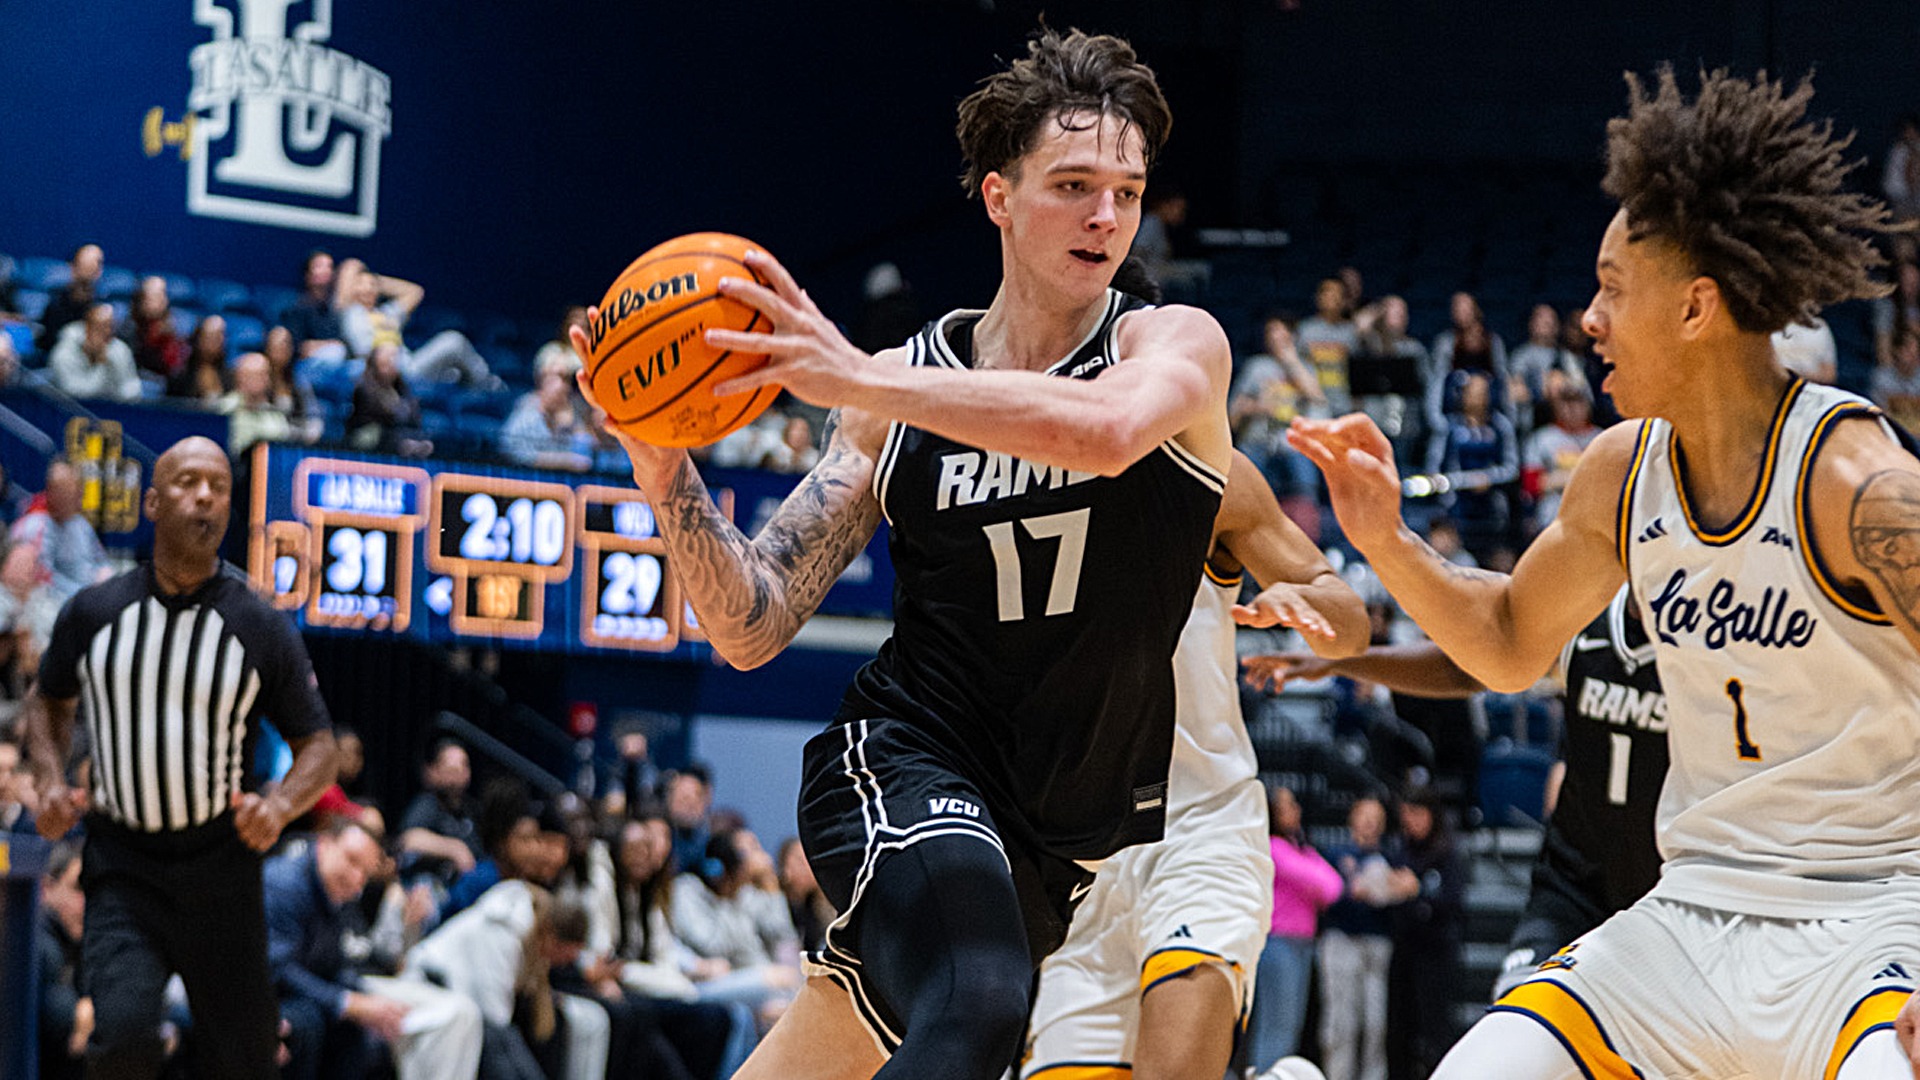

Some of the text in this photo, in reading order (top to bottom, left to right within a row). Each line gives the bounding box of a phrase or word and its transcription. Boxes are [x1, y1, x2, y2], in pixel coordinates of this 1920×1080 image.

[590, 272, 697, 355] Wilson
[617, 340, 680, 401] EVO
[936, 449, 1100, 511] RAM
[326, 527, 387, 594] 31
[460, 493, 565, 565] 2:10
[601, 552, 662, 615] 29
[982, 507, 1091, 622] 17
[1650, 568, 1817, 650] La Salle
[1578, 676, 1668, 733] RAMS
[1726, 676, 1763, 762] 1
[1608, 731, 1632, 804] 1
[928, 797, 981, 818] VCU
